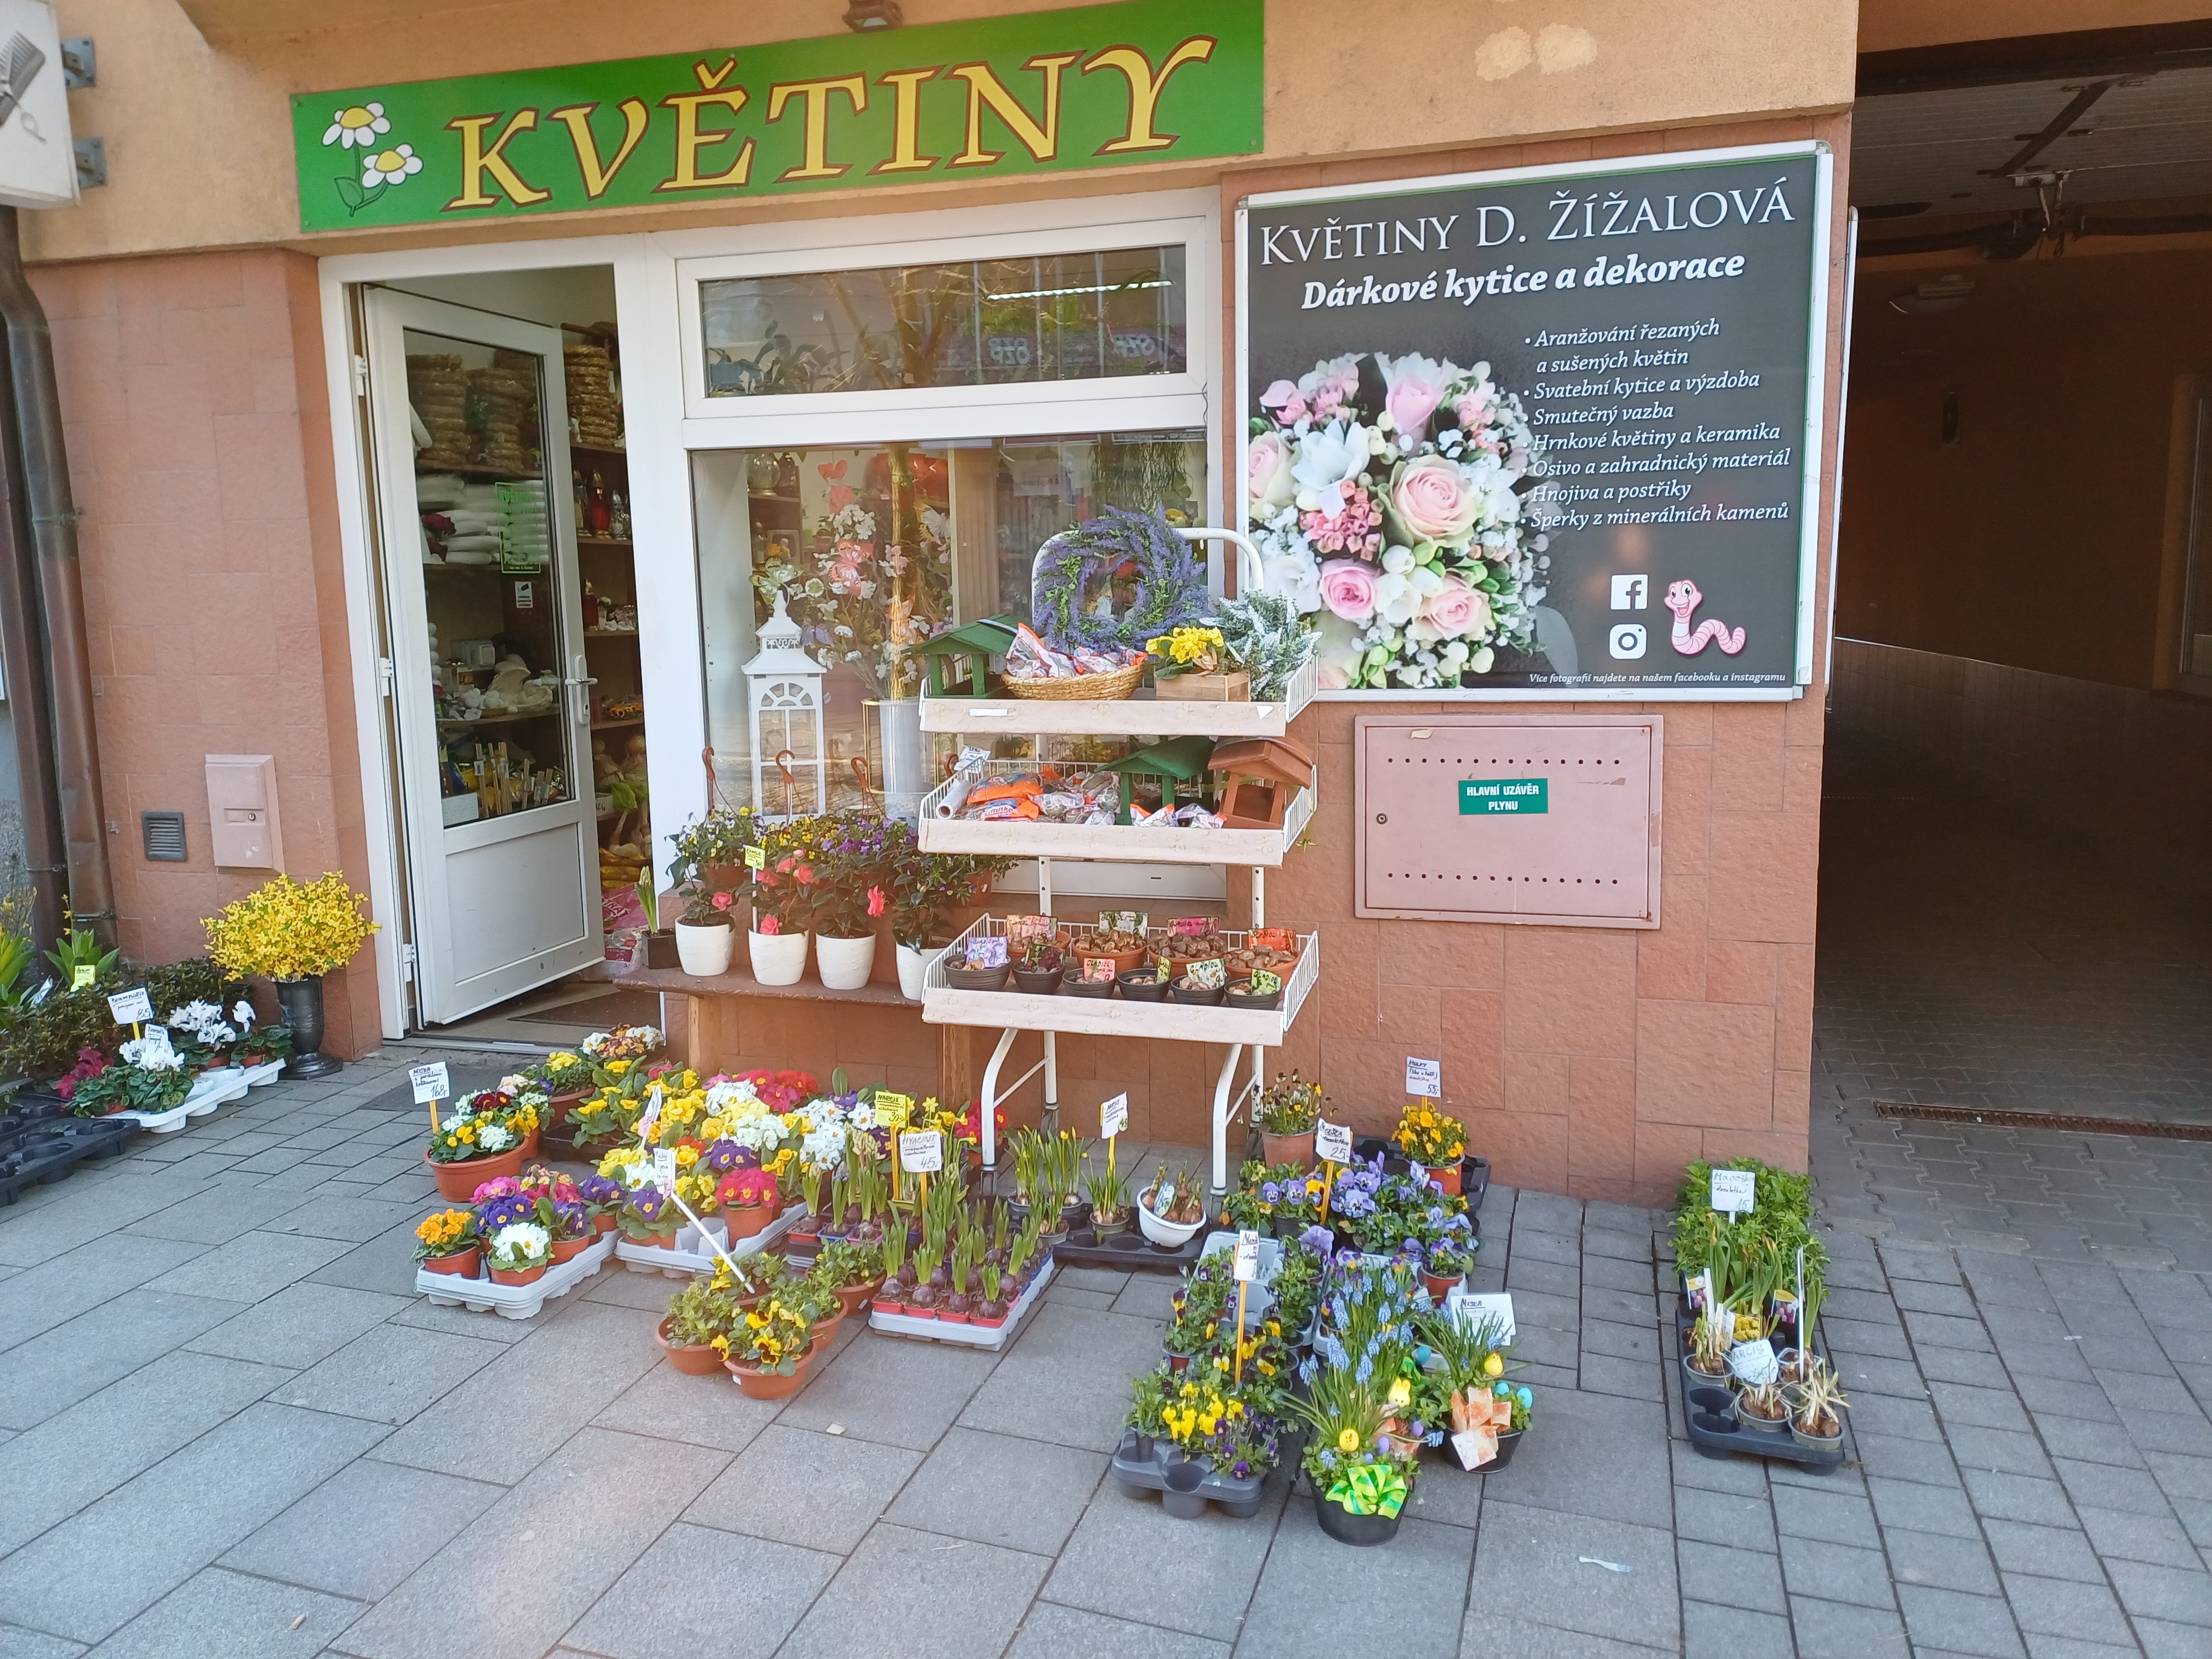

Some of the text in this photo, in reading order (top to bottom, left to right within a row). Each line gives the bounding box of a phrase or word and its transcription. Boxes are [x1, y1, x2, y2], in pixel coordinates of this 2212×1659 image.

[441, 34, 1218, 212] KVĚTINY
[1260, 177, 1796, 265] KVĚTINY D. ŽÍŽALOVÁ
[1301, 252, 1745, 310] Dárkové kytice a dekorace
[1534, 318, 1720, 347] Aranžování řezaných
[1536, 349, 1688, 374] a sušených květin
[1534, 370, 1760, 400] Svatební kytice a výzdoba
[1533, 401, 1674, 426] Smutečný vazba
[1532, 422, 1781, 451] Hrnkové květiny a keramika
[1533, 448, 1791, 477] Osivo a zahradnický materiál
[1532, 479, 1692, 505] Hnojiva a postřiky
[1531, 502, 1789, 531] Šperky z minerálních kamenů
[1530, 674, 1548, 682] Více
[1550, 673, 1592, 685] fotografií
[1593, 673, 1626, 684] najdete
[1642, 673, 1672, 682] našem
[1674, 672, 1721, 683] facebooku
[1731, 672, 1786, 684] instagramu
[1466, 782, 1540, 796] HLAVNÍ UZÁVĚR
[1488, 801, 1519, 811] PLYNU
[902, 1134, 937, 1145] HYACINT
